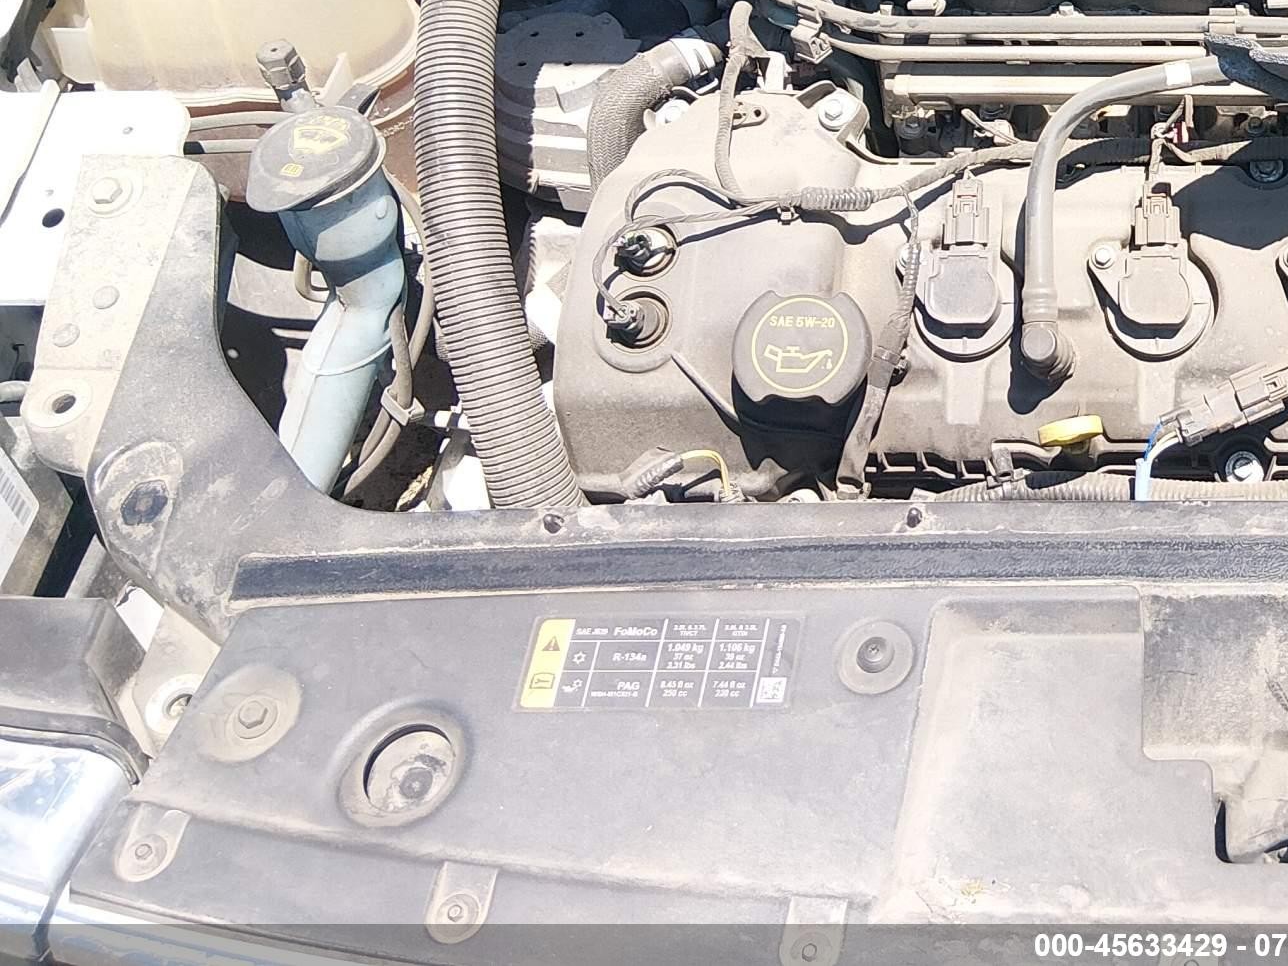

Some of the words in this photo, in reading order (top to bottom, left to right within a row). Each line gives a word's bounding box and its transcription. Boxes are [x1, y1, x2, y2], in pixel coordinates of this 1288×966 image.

[769, 315, 793, 327] SAE
[795, 316, 835, 328] 5W-20
[613, 626, 658, 636] FoMoCo
[667, 643, 691, 652] 1.049
[692, 643, 704, 654] kg
[719, 643, 743, 652] 1.106
[743, 643, 756, 654] kg
[612, 652, 647, 662] R-134a
[673, 652, 684, 660] 37
[683, 661, 696, 669] lbs
[735, 661, 748, 669] lbs
[617, 681, 640, 690] PAG
[677, 680, 684, 688] fl
[729, 680, 736, 688] fl
